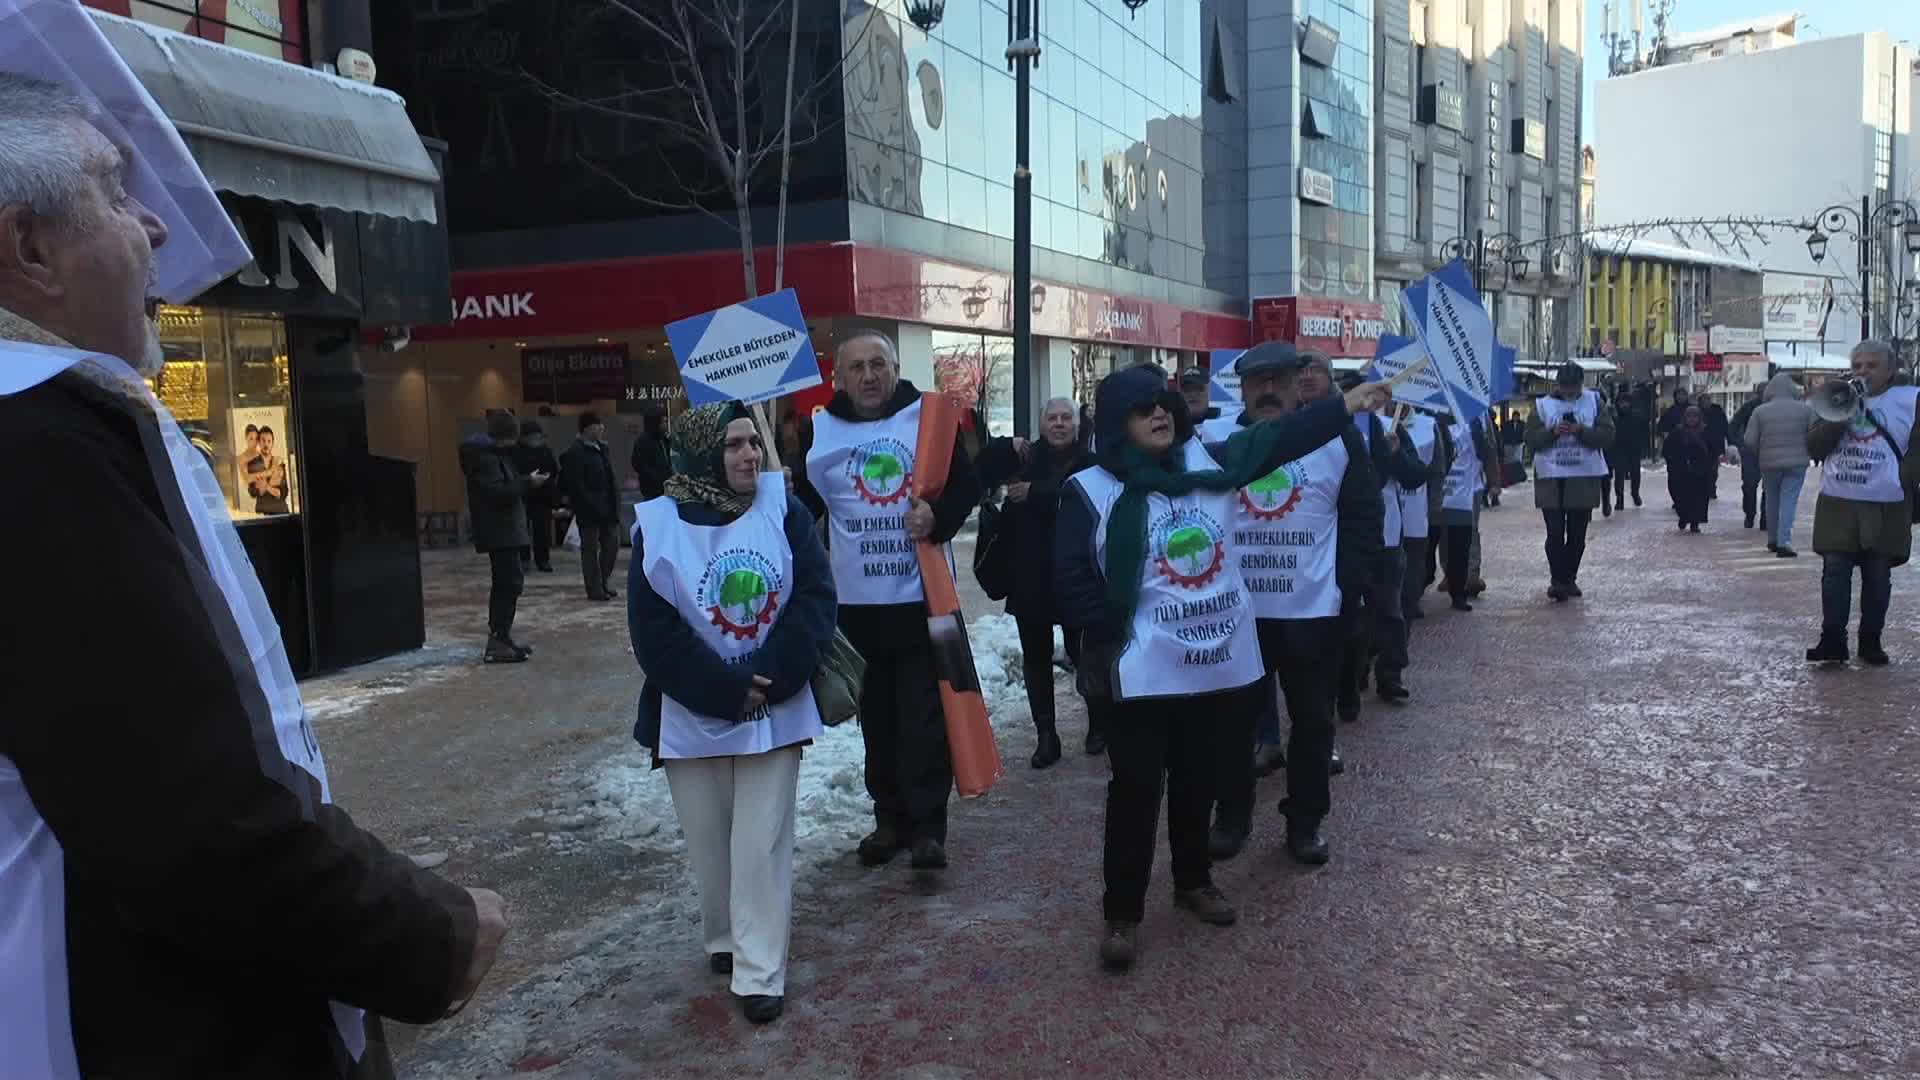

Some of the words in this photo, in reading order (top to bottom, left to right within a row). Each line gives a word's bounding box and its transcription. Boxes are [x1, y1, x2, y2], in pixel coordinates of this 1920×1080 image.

[1302, 317, 1341, 337] BEREKET
[687, 344, 743, 369] EMEKÇİLER
[743, 329, 797, 352] BÜTÇEDEN
[705, 362, 747, 384] HAKKINI
[749, 350, 789, 371] İSTİYOR!
[860, 535, 913, 557] SENDİKASI
[1248, 527, 1317, 546] EMEKLİLERİN
[863, 558, 913, 577] KARABÜK
[1240, 551, 1298, 570] SENDİKASI
[1175, 616, 1237, 643] SENDİKASI
